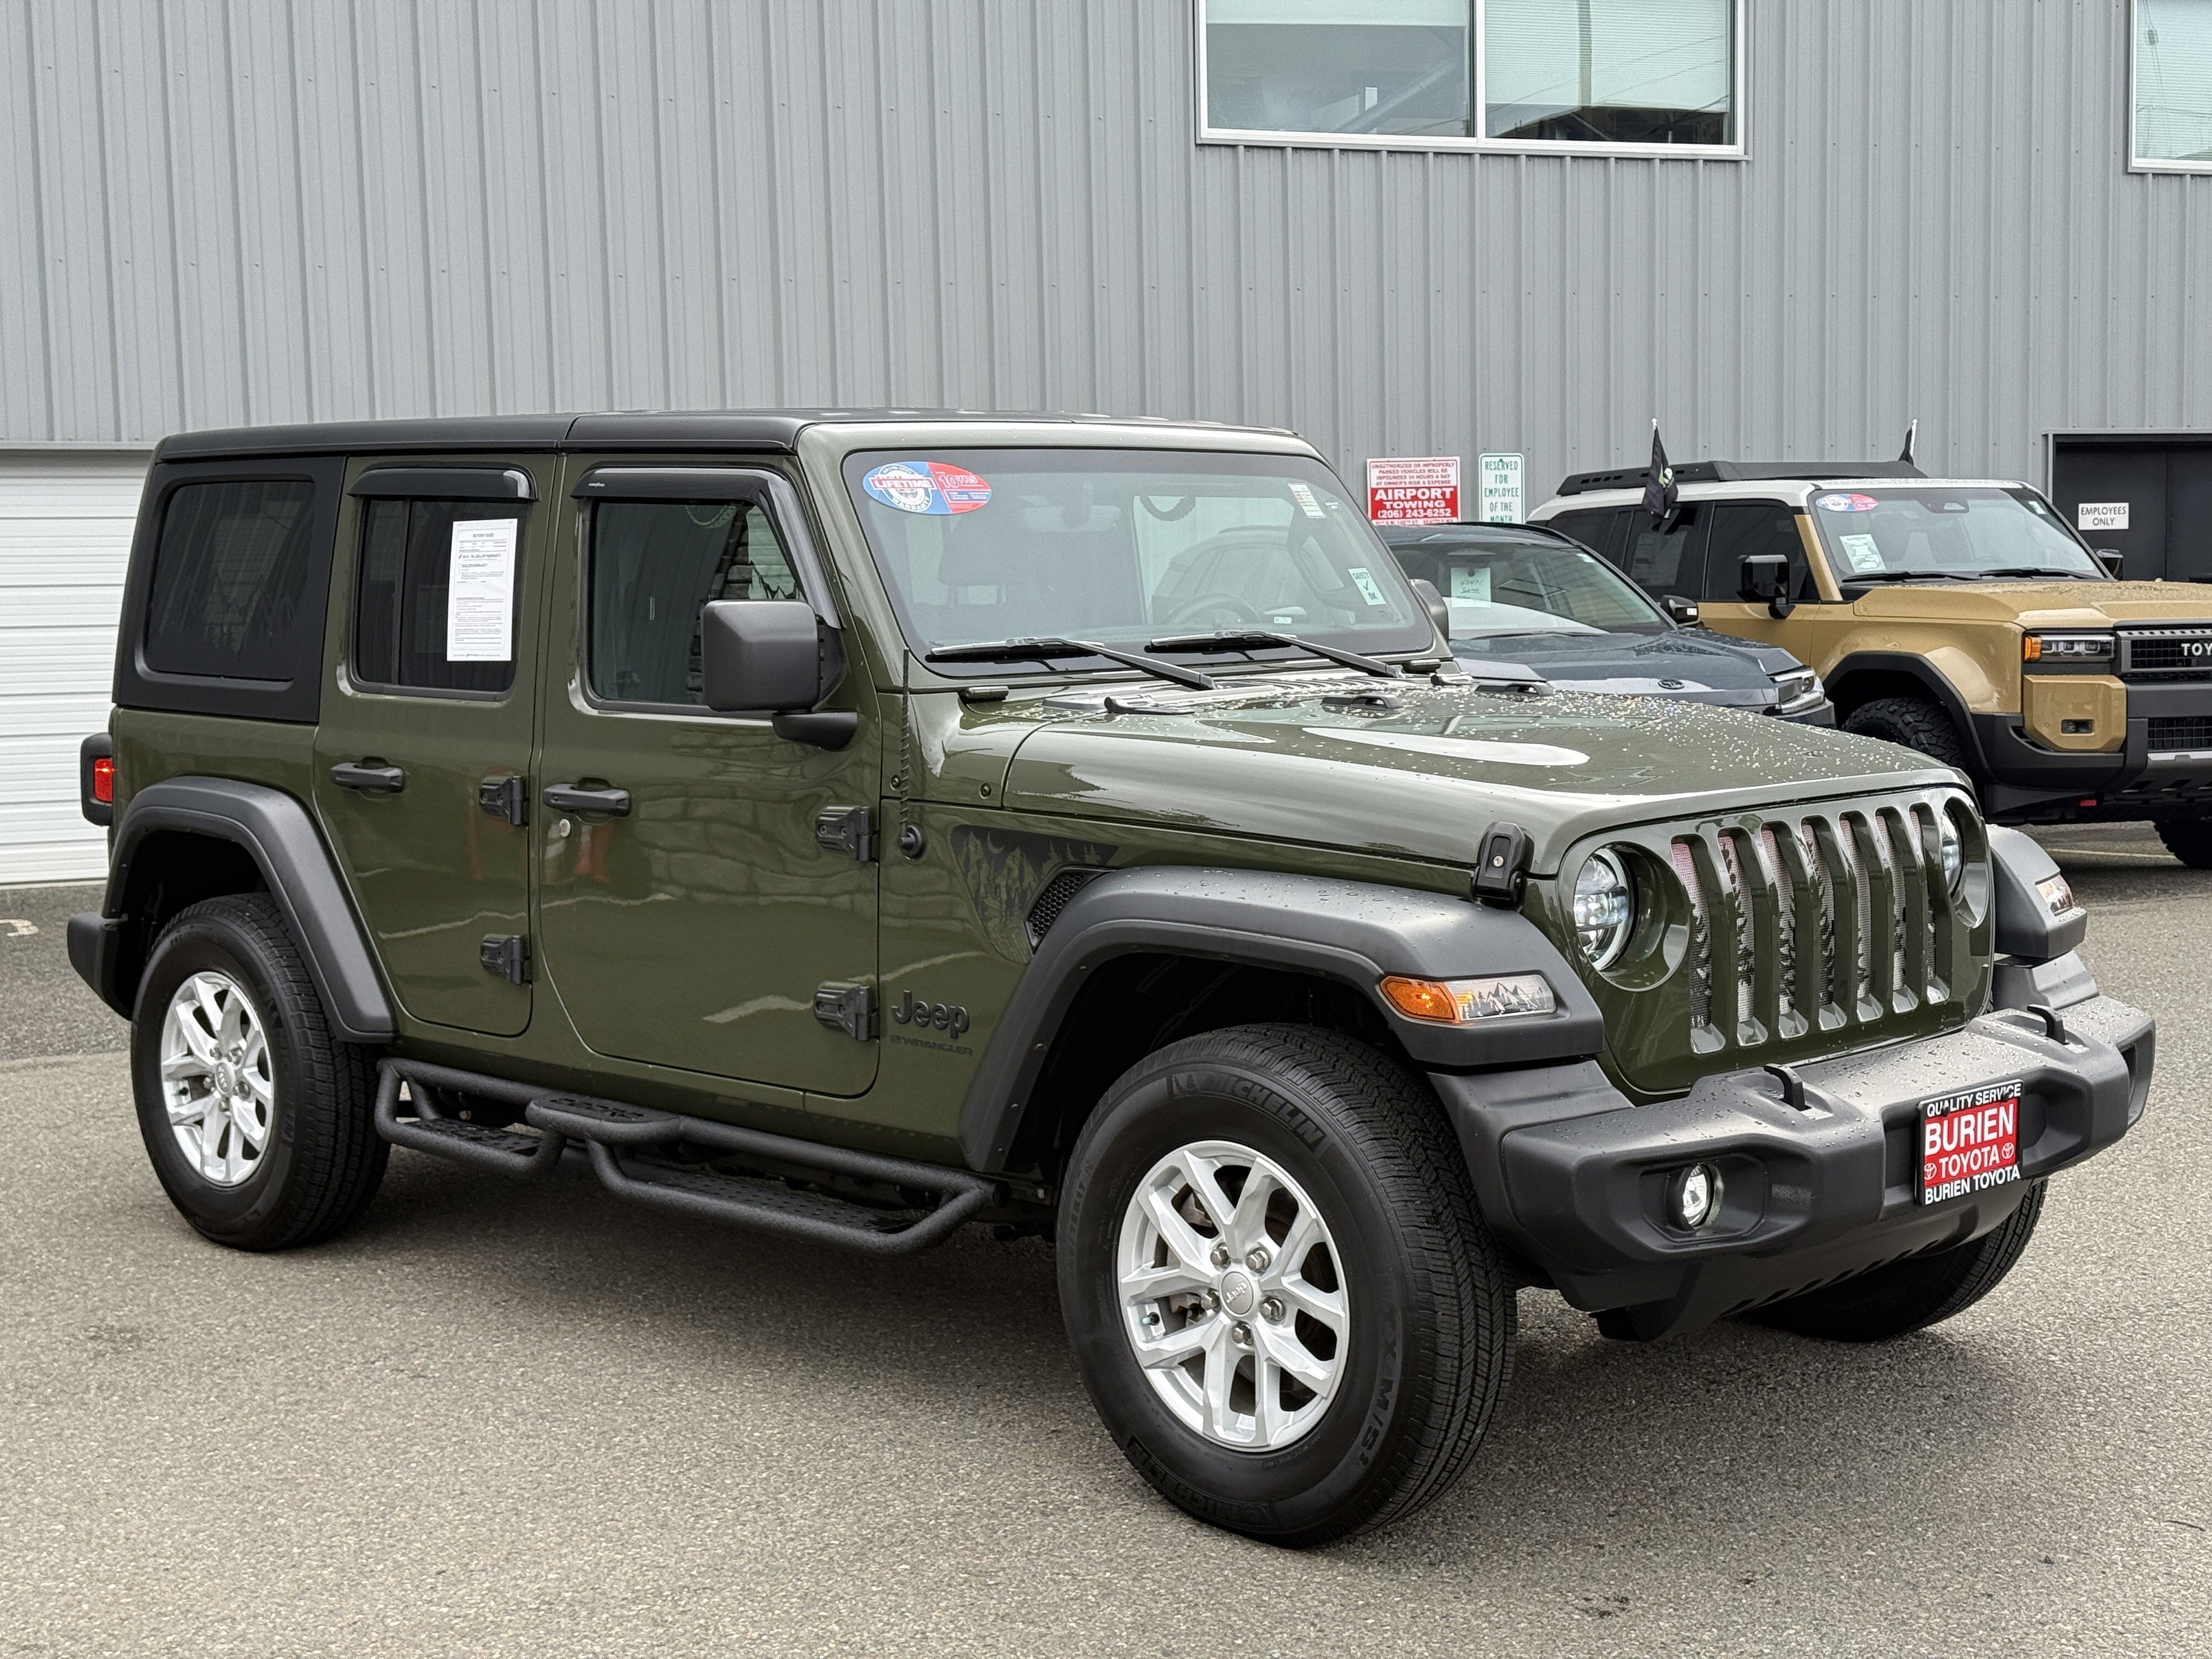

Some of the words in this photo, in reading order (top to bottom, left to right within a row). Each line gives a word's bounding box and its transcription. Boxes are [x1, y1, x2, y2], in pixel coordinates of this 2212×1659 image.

[1485, 461, 1518, 470] RESERVED
[873, 479, 933, 488] LIFETIME
[1494, 474, 1508, 483] FOR
[1374, 488, 1454, 501] AIRPORT
[1484, 487, 1519, 497] EMPLOYEE
[1383, 500, 1446, 509] TOWING
[1489, 502, 1498, 512] OF
[1500, 501, 1513, 512] THE
[1377, 510, 1404, 518] (206)
[1405, 508, 1452, 518] 243-6252
[2081, 506, 2126, 515] EMPLOYEES
[2092, 517, 2115, 526] ONLY
[1352, 572, 1370, 580] SAFETY
[1368, 592, 1378, 600] OK
[2181, 642, 2212, 657] TOY
[891, 989, 970, 1039] Jeep
[902, 1036, 973, 1056] WRANGLER
[1927, 1094, 1975, 1118] QUALITY
[1975, 1083, 2022, 1106] SERVICE
[1204, 1073, 1324, 1145] MICHELIN
[1925, 1103, 2015, 1156] BURIEN
[1938, 1144, 2001, 1180] TOYOTA
[1925, 1177, 1971, 1205] BURIEN
[1973, 1164, 2021, 1192] TOYOTA
